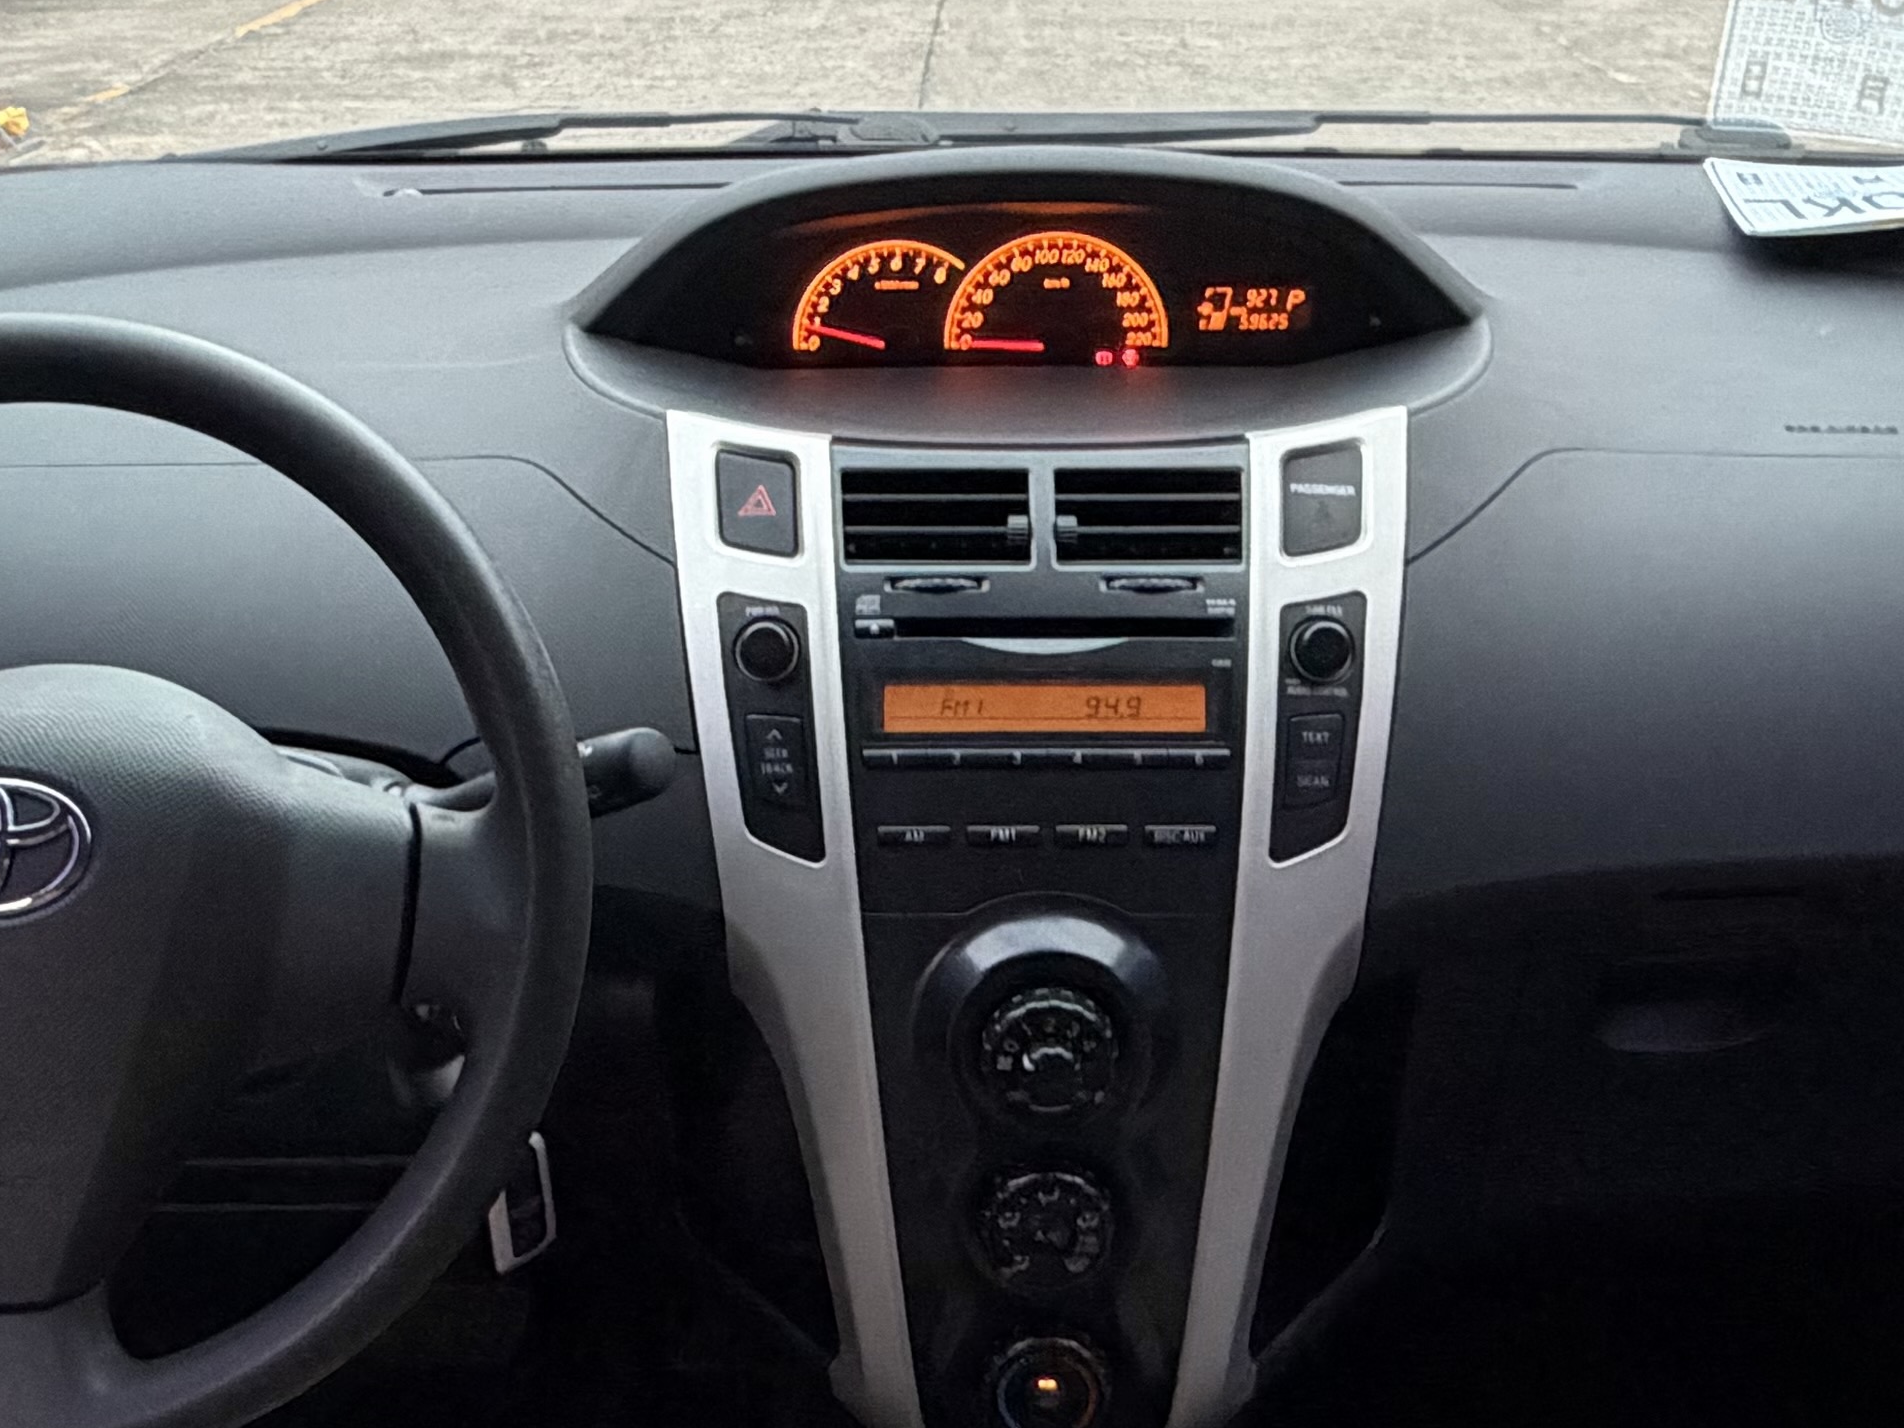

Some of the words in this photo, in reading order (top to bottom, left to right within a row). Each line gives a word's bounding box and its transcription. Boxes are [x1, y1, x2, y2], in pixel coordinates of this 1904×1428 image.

[1034, 249, 1060, 265] 100
[1061, 248, 1086, 265] 120
[1286, 289, 1306, 312] P
[961, 311, 984, 329] 20
[1085, 696, 1142, 718] 94.9
